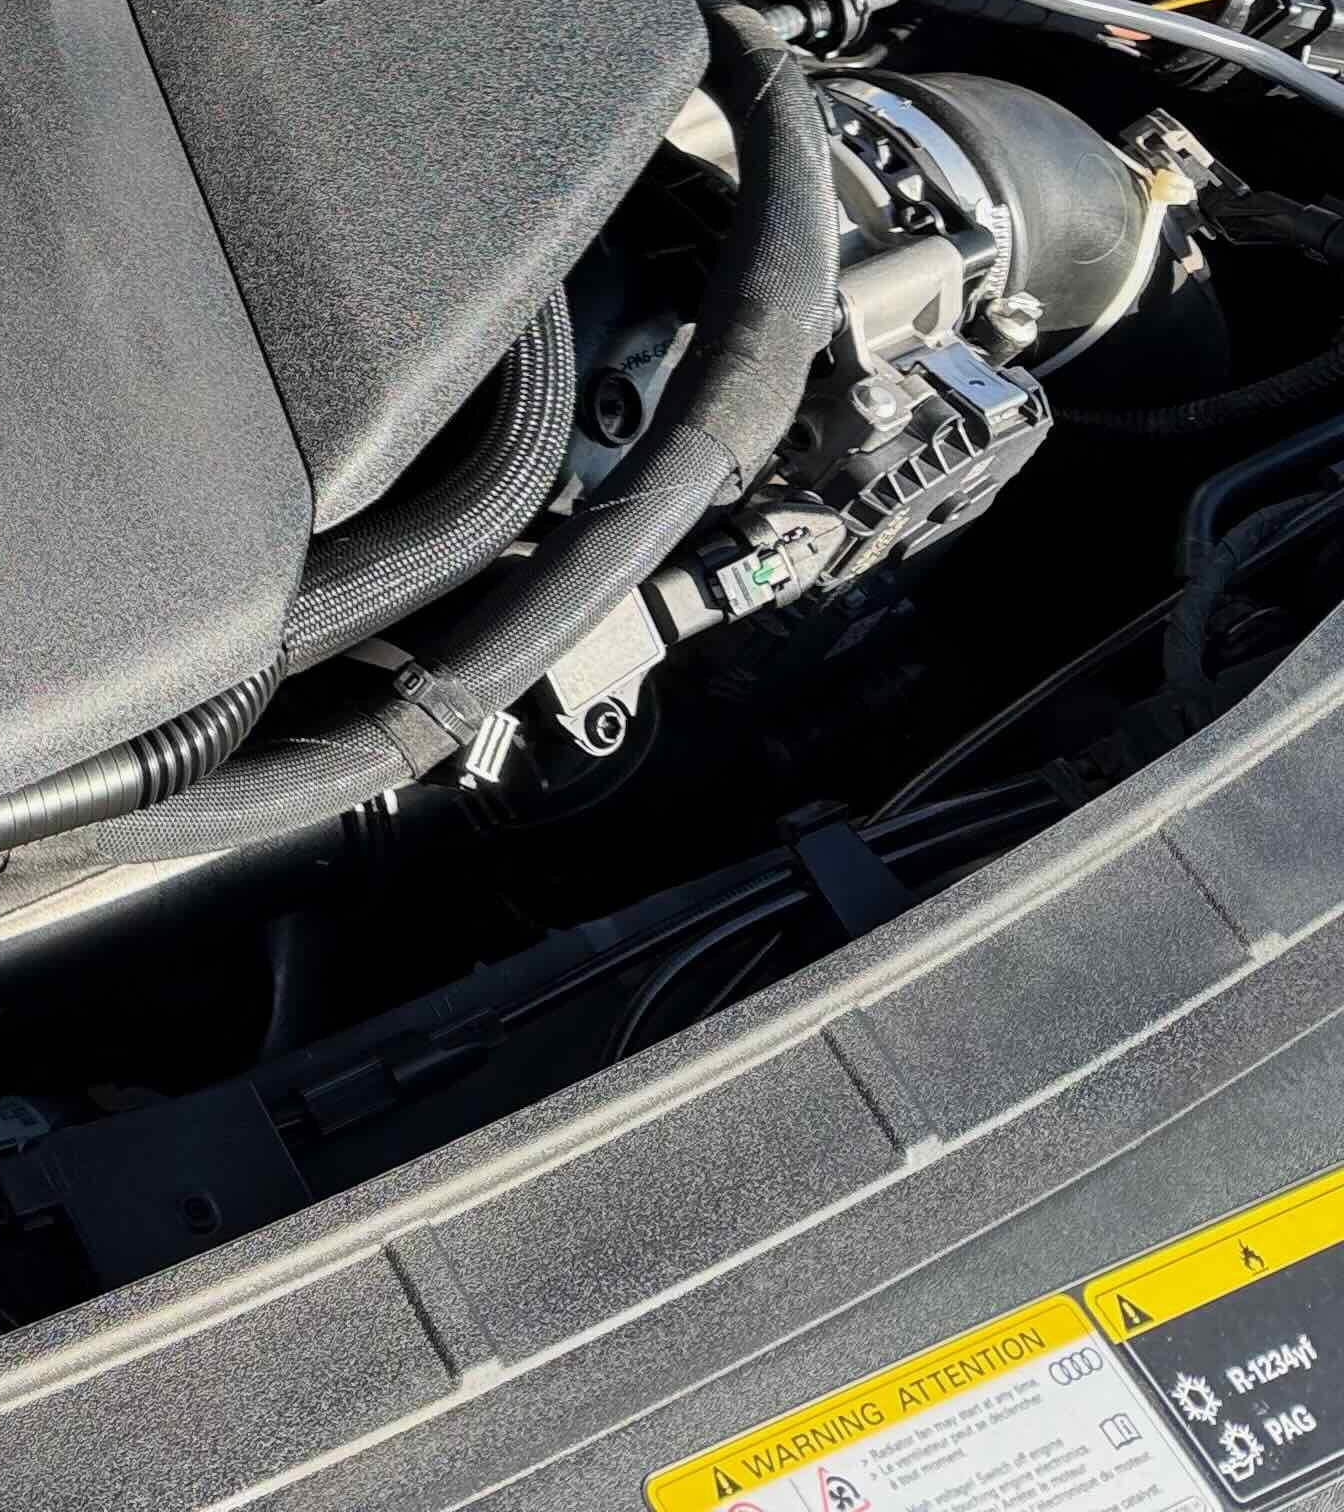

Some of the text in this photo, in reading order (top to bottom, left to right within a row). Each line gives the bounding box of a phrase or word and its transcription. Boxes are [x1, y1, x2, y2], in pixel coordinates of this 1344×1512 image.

[1225, 1333, 1319, 1395] R-1234yf
[742, 1326, 1047, 1480] WARNING ATTENTION
[1263, 1404, 1318, 1446] PAG
